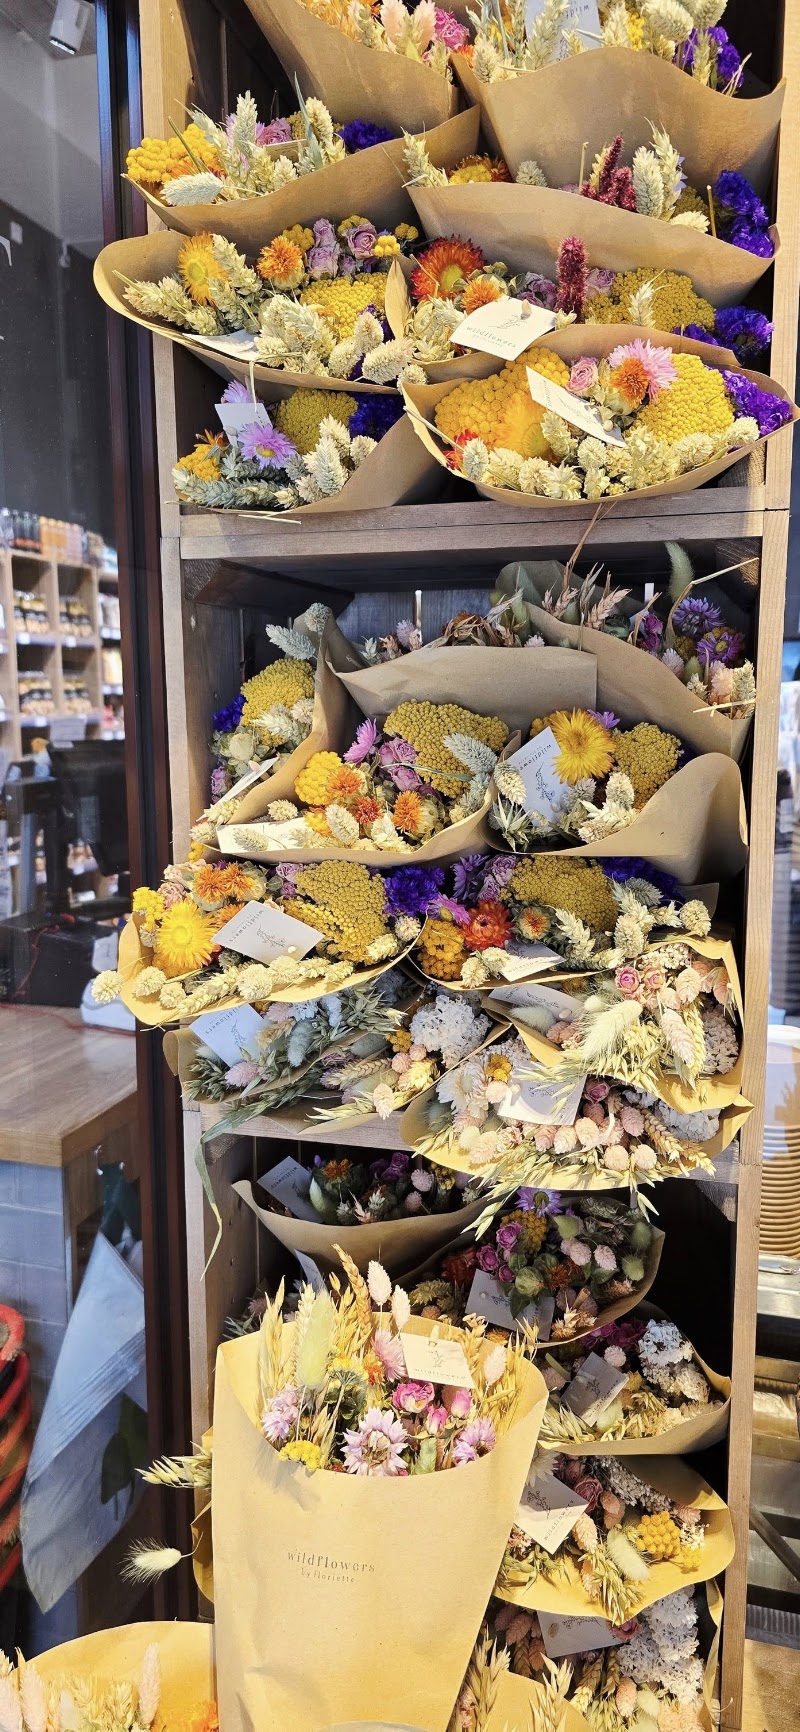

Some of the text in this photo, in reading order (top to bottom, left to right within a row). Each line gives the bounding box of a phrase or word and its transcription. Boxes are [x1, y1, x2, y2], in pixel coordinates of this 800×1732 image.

[466, 326, 516, 347] wildflowers
[287, 1551, 375, 1573] wildflowers
[301, 1567, 355, 1583] by floriette
